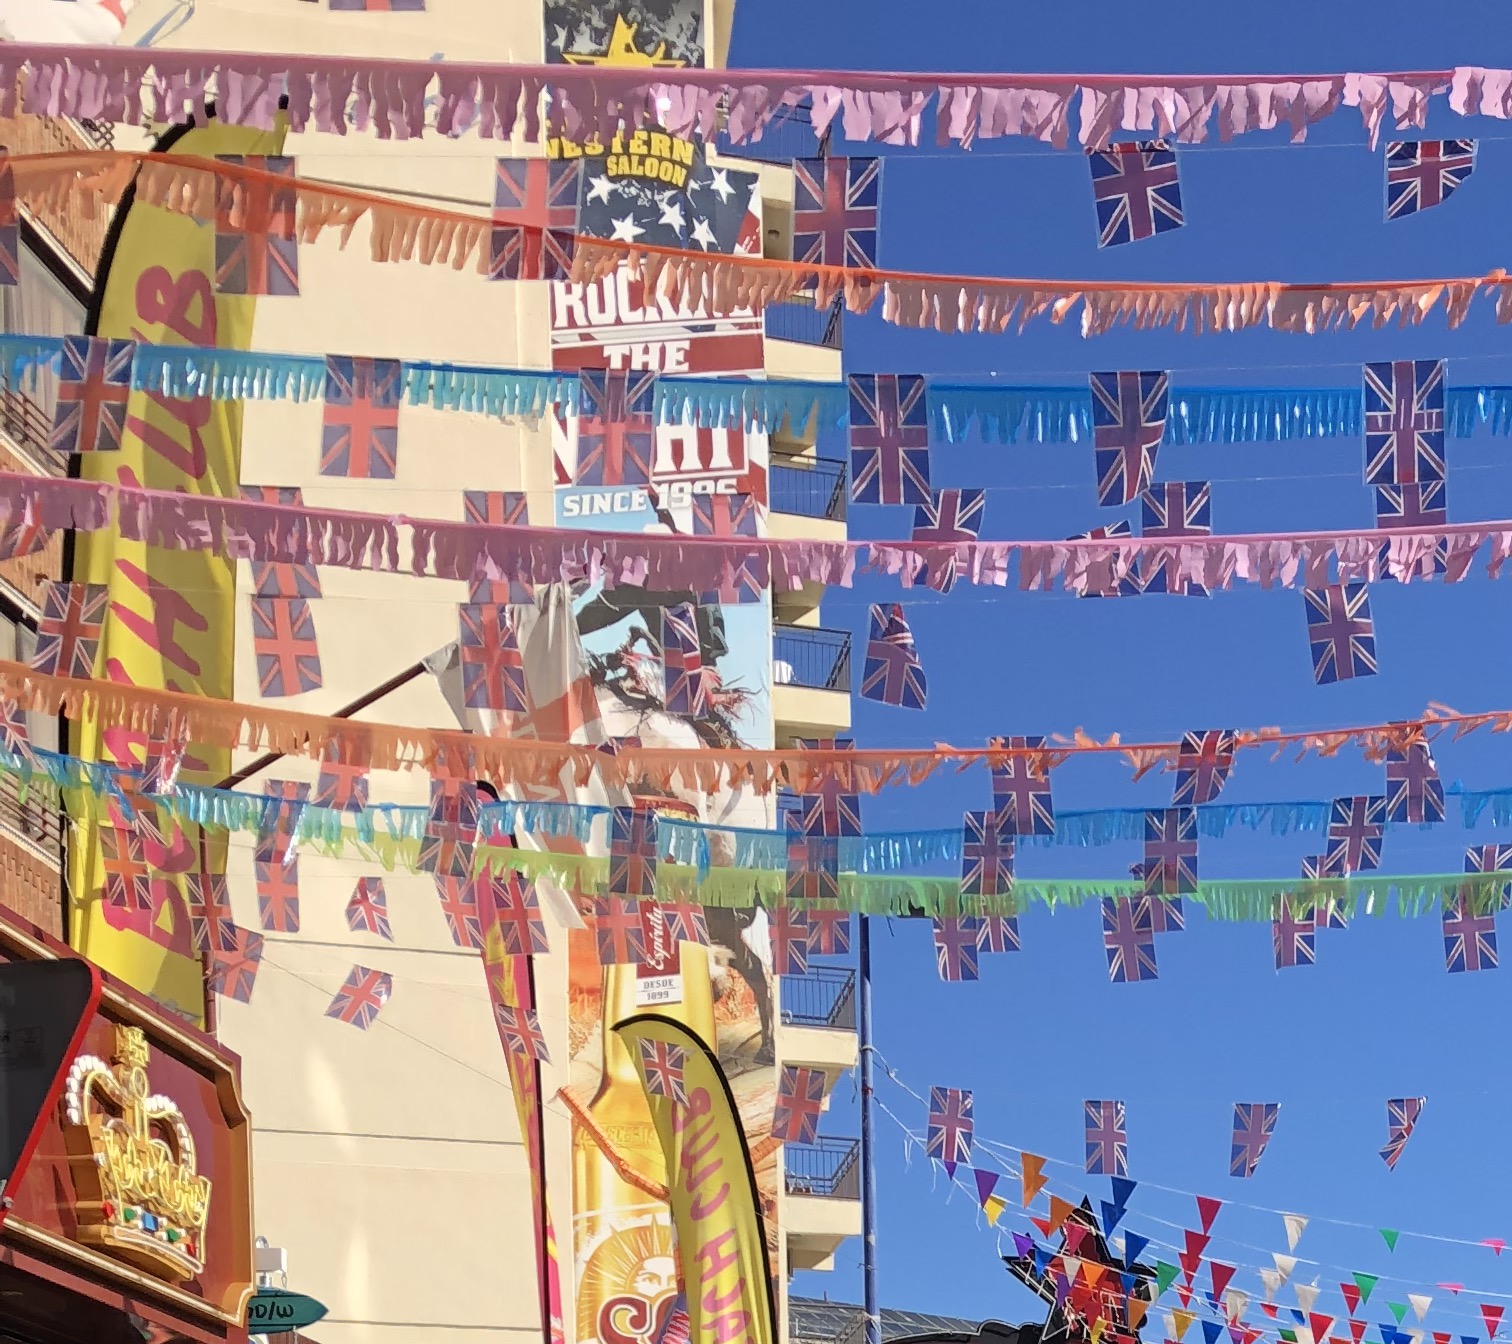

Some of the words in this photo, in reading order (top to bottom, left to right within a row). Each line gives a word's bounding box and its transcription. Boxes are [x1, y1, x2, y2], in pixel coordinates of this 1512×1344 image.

[607, 156, 688, 188] SALOON
[603, 340, 691, 372] THE
[562, 488, 648, 518] SINCE
[642, 979, 675, 991] DESDE
[646, 990, 670, 1001] 1899
